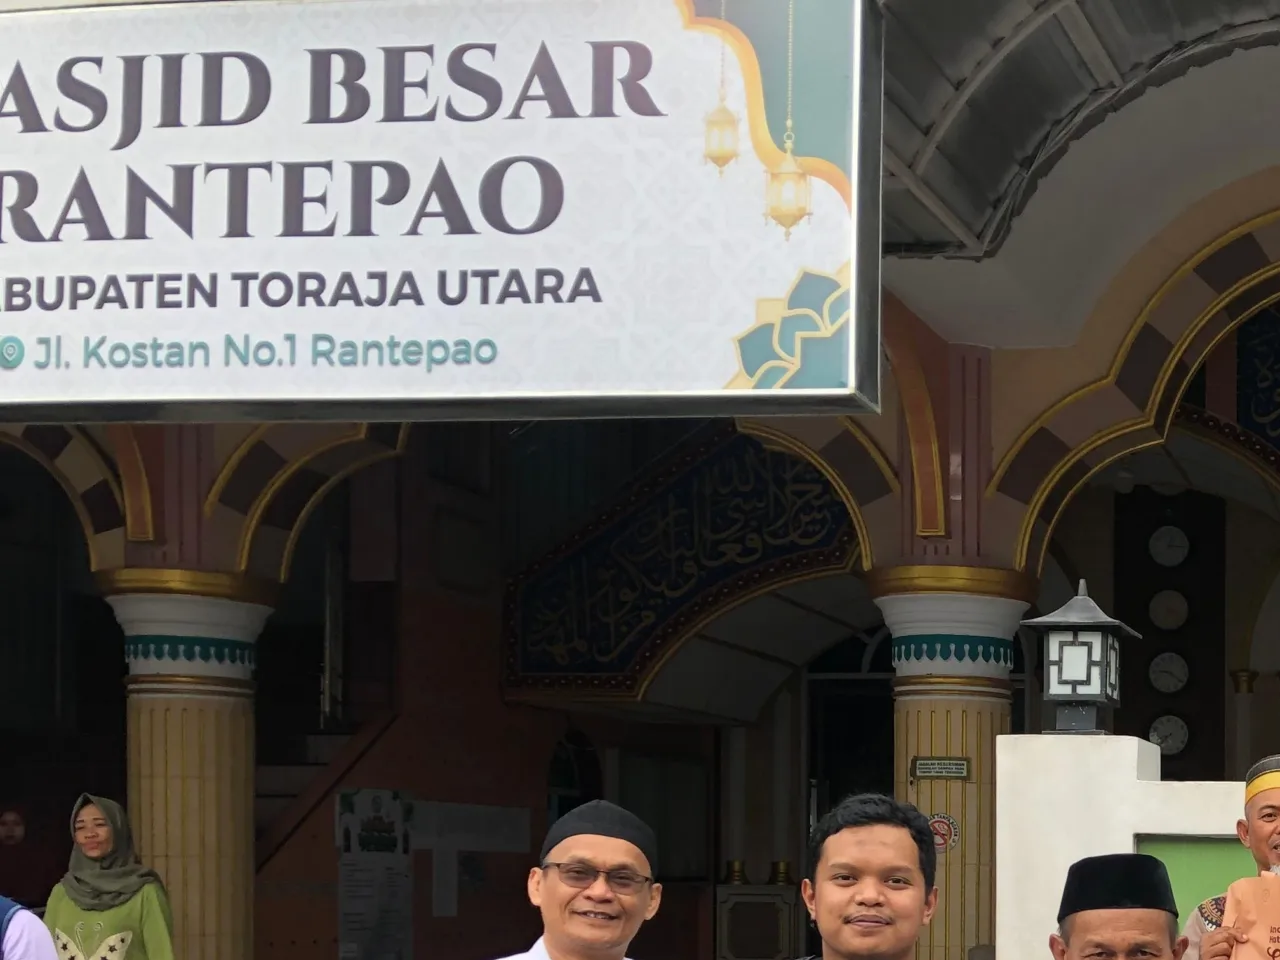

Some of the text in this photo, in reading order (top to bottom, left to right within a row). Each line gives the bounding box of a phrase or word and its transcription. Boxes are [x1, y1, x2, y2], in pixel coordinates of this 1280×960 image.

[0, 40, 667, 151] ASJID BESAR
[0, 156, 565, 243] RANTEPAO
[0, 267, 602, 312] BUPATEN TORAJA UTARA
[34, 333, 498, 372] Jl. Kostan No.1 Rantepao
